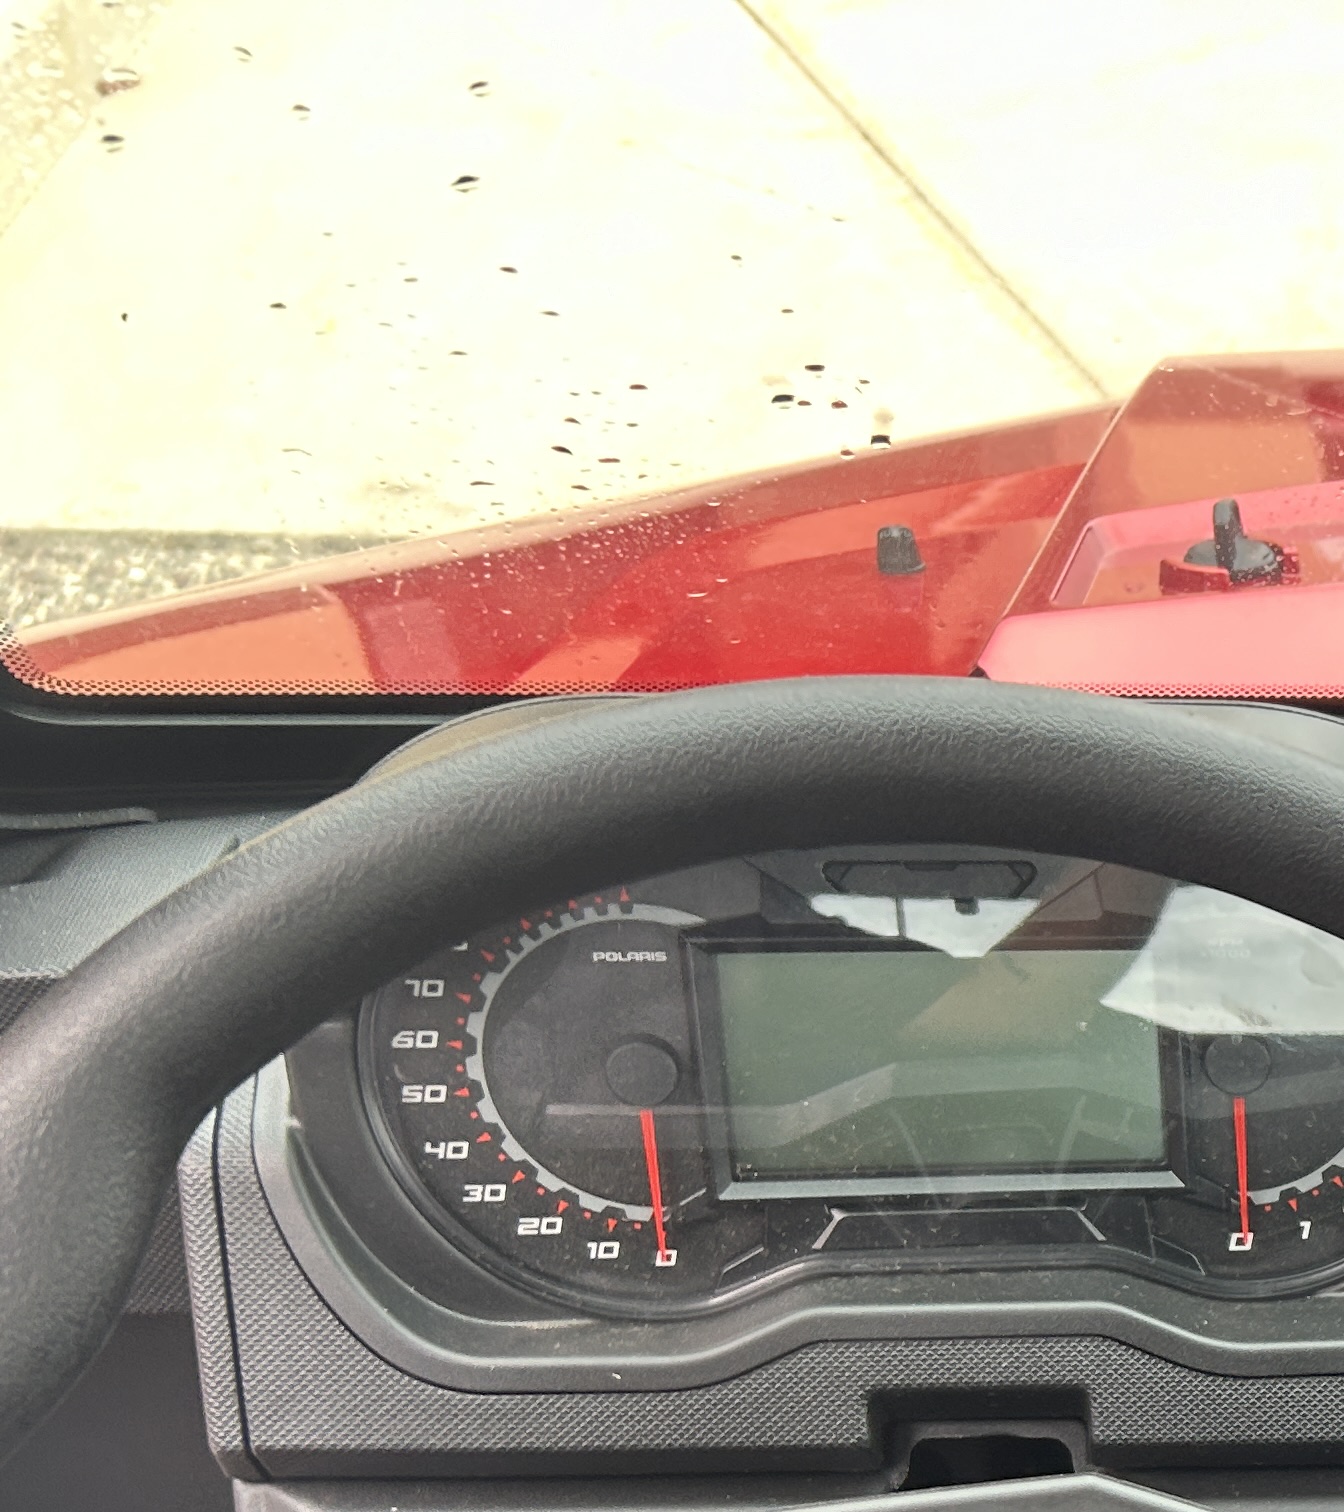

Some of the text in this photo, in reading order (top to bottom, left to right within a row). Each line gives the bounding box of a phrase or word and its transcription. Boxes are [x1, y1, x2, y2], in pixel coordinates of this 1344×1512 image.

[592, 950, 668, 963] POLARIS
[404, 977, 445, 998] 70
[391, 1029, 439, 1050] 60
[402, 1084, 448, 1104] 50
[424, 1139, 470, 1160] 40
[462, 1183, 507, 1203] 30
[517, 1216, 564, 1236] 20
[1299, 1220, 1312, 1240] 1
[586, 1240, 621, 1260] 10
[1228, 1231, 1254, 1252] 0
[654, 1247, 678, 1268] 0
